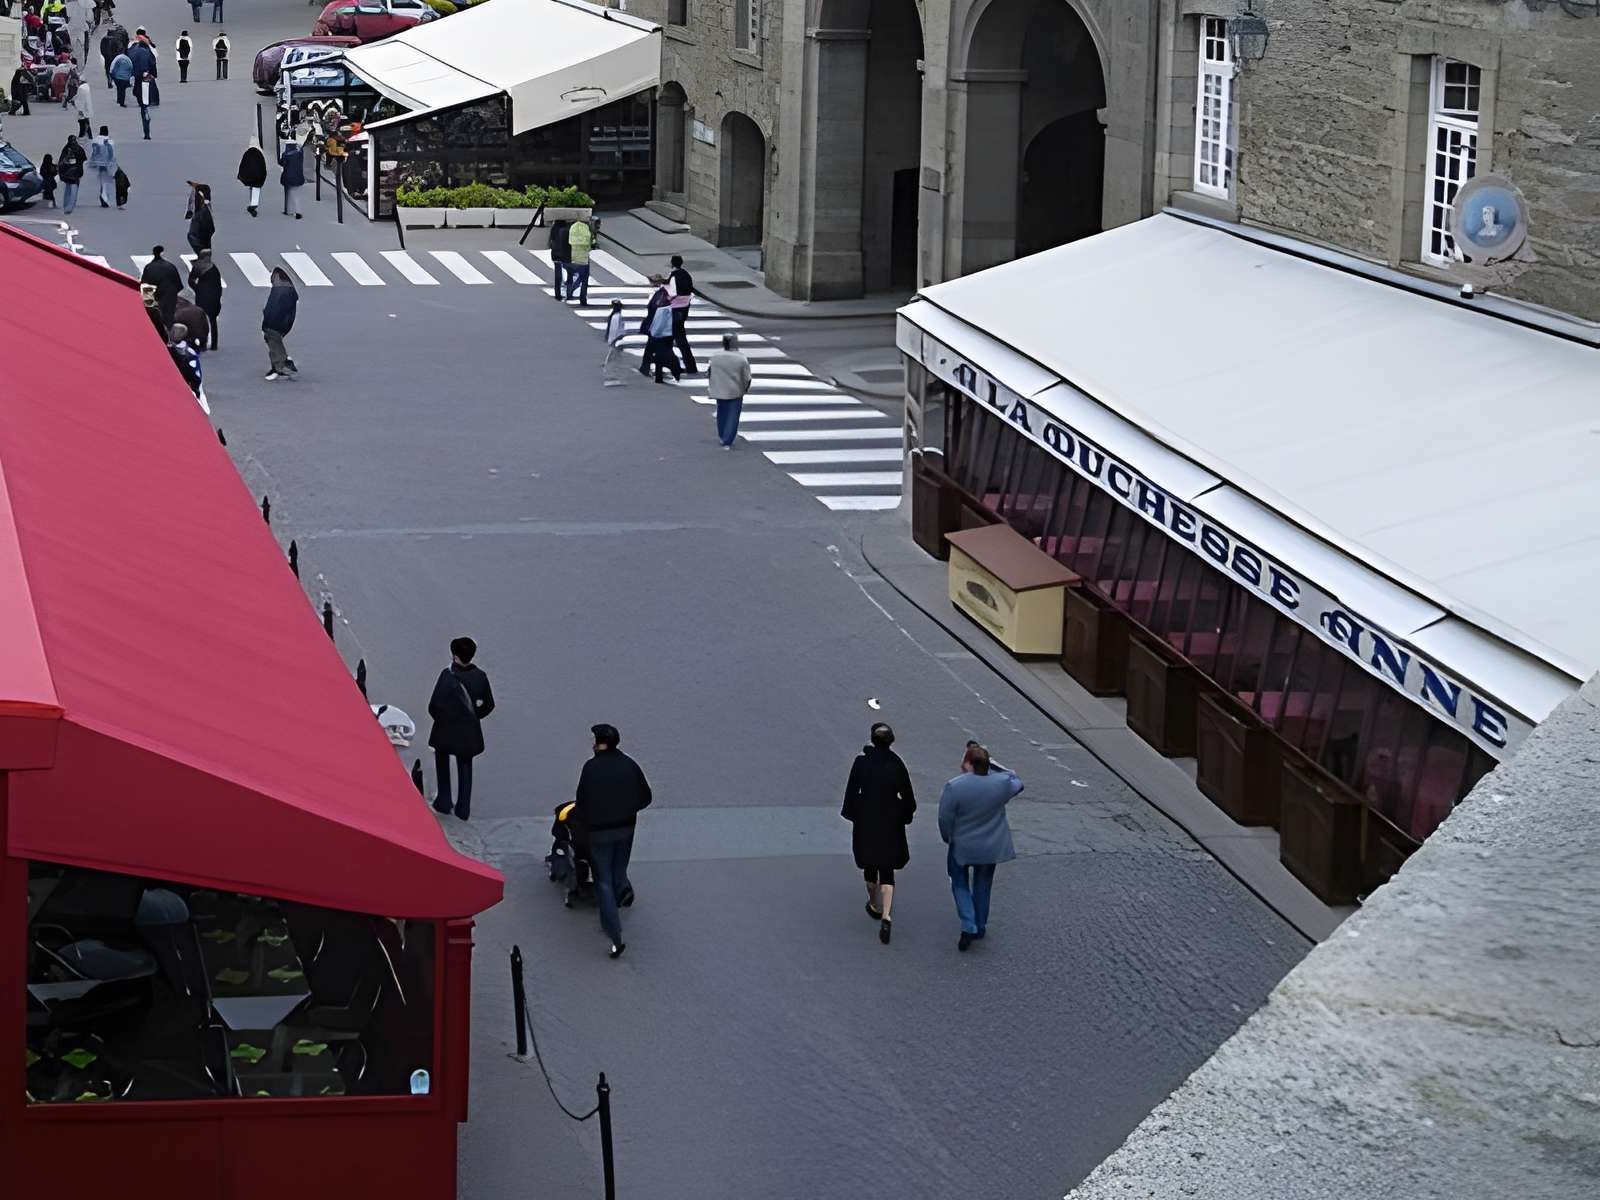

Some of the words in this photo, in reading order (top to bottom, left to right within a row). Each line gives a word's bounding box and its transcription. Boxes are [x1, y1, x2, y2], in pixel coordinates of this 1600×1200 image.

[952, 363, 977, 396] A
[987, 379, 1033, 435] LA
[1042, 422, 1301, 611] DUCHESSE
[1320, 610, 1508, 750] ANNE
